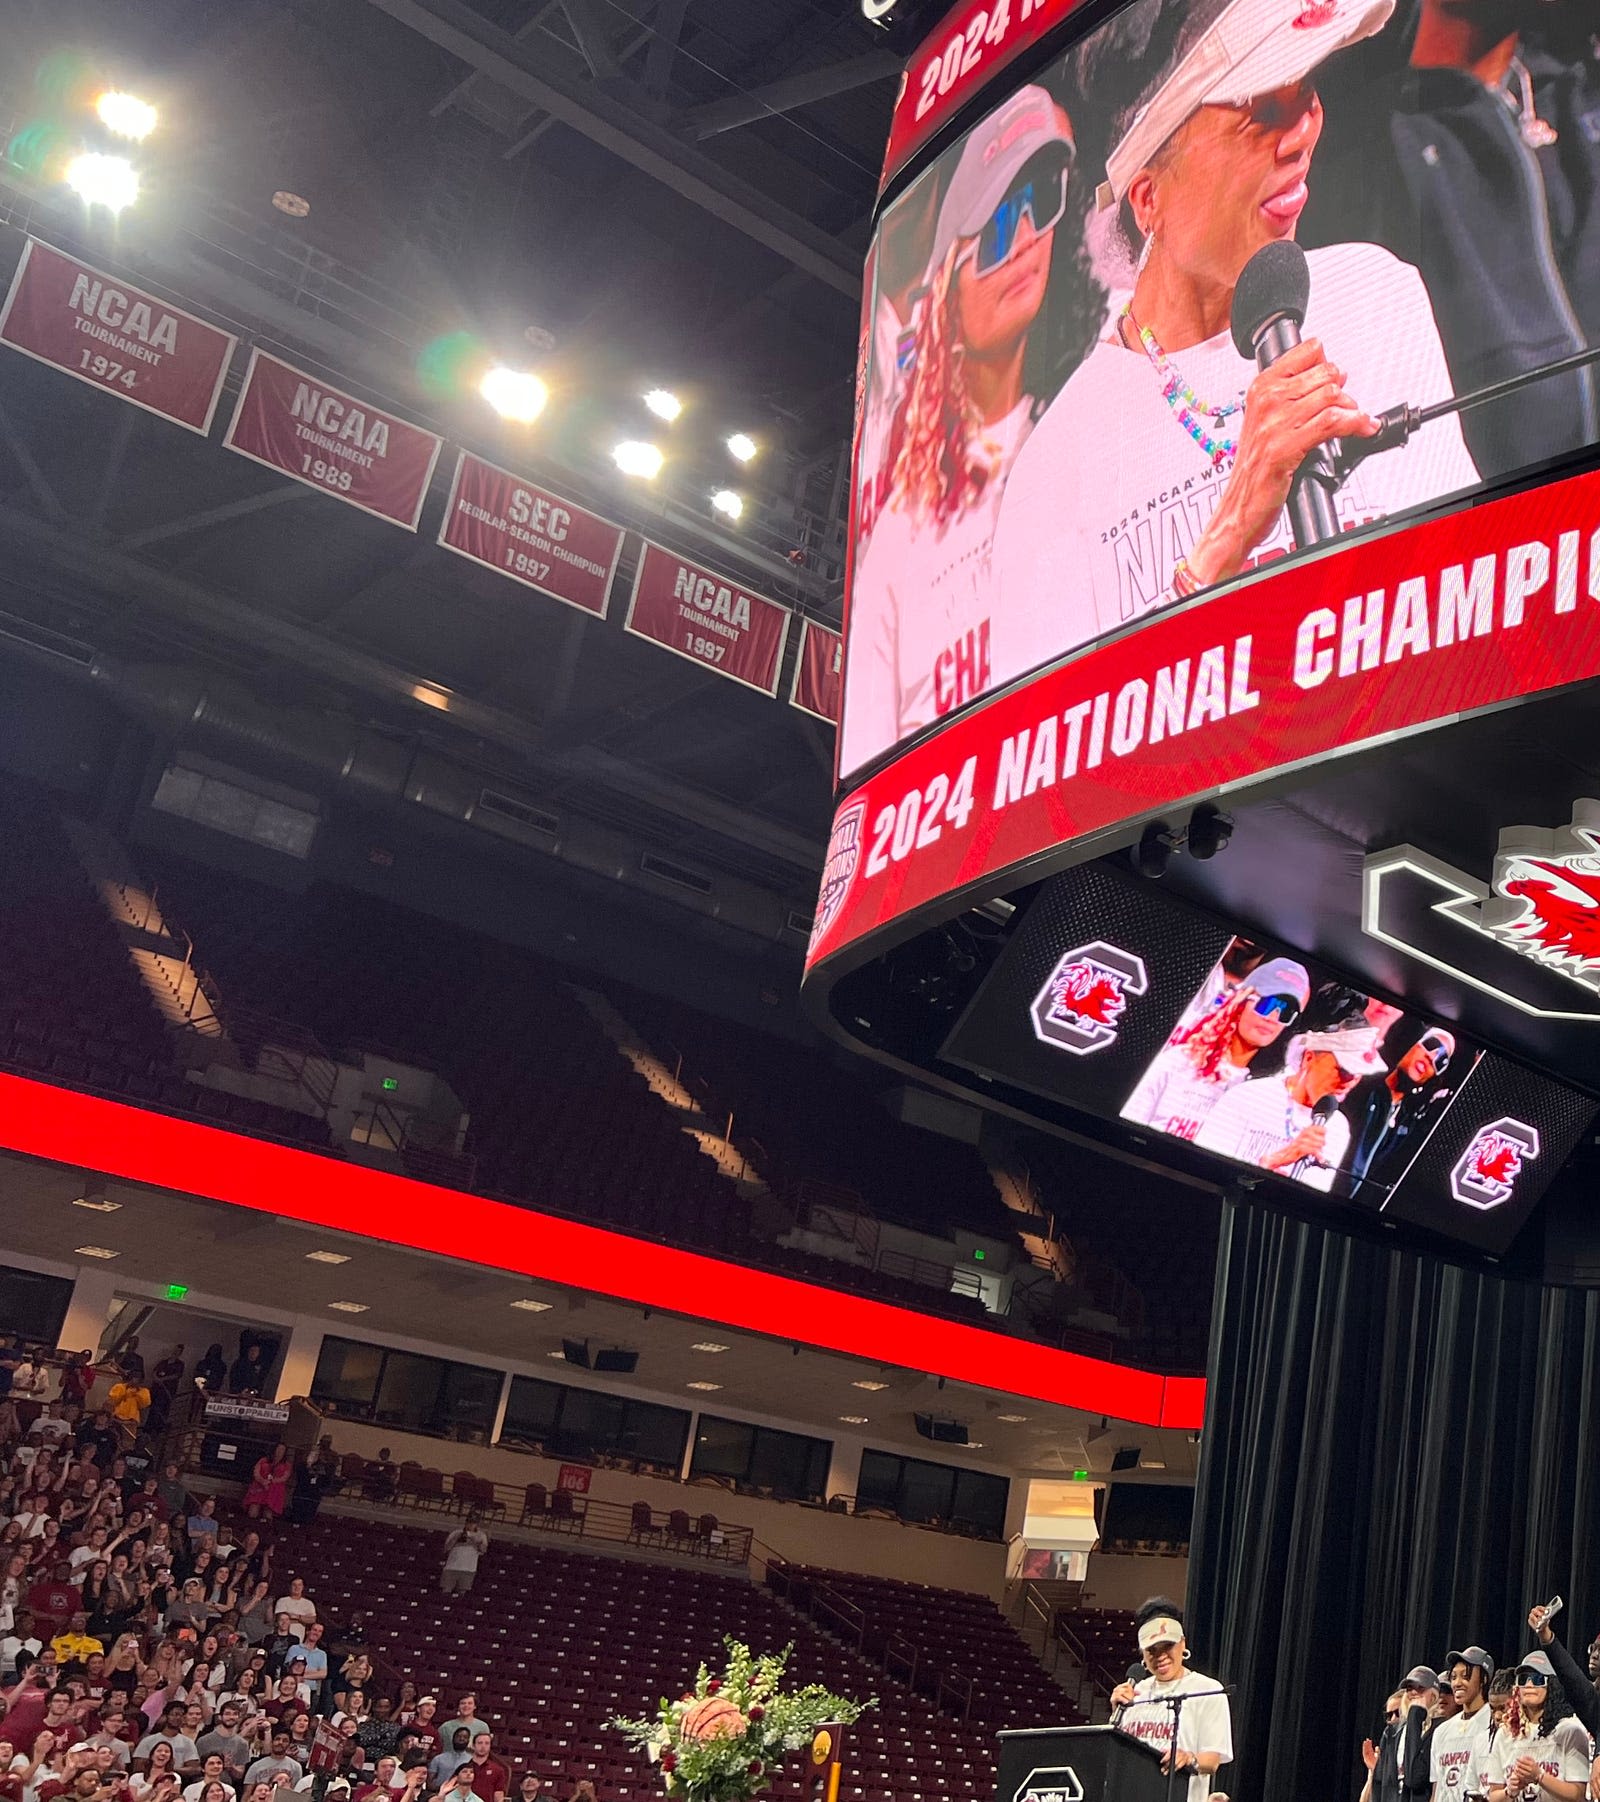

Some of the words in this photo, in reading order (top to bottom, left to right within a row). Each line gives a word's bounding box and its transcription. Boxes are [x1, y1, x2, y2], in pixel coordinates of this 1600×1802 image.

[914, 0, 1011, 122] 2024
[68, 273, 178, 355] NCAA
[74, 316, 162, 367] TOURNAMENT
[79, 349, 137, 389] 1974
[290, 382, 390, 458] NCAA
[295, 423, 375, 469] TOURNAMENT
[302, 454, 353, 491] 1989
[458, 498, 551, 553] REGULAR-SEASON
[552, 545, 606, 578] CHAMPION
[508, 488, 571, 542] SEC
[1100, 509, 1140, 544] 2024
[505, 548, 550, 581] 1997
[673, 567, 751, 632] NCAA
[679, 603, 740, 642] TOURNAMENT
[685, 632, 726, 663] 1997
[865, 755, 978, 880] 2024
[992, 634, 1261, 811] NATIONAL
